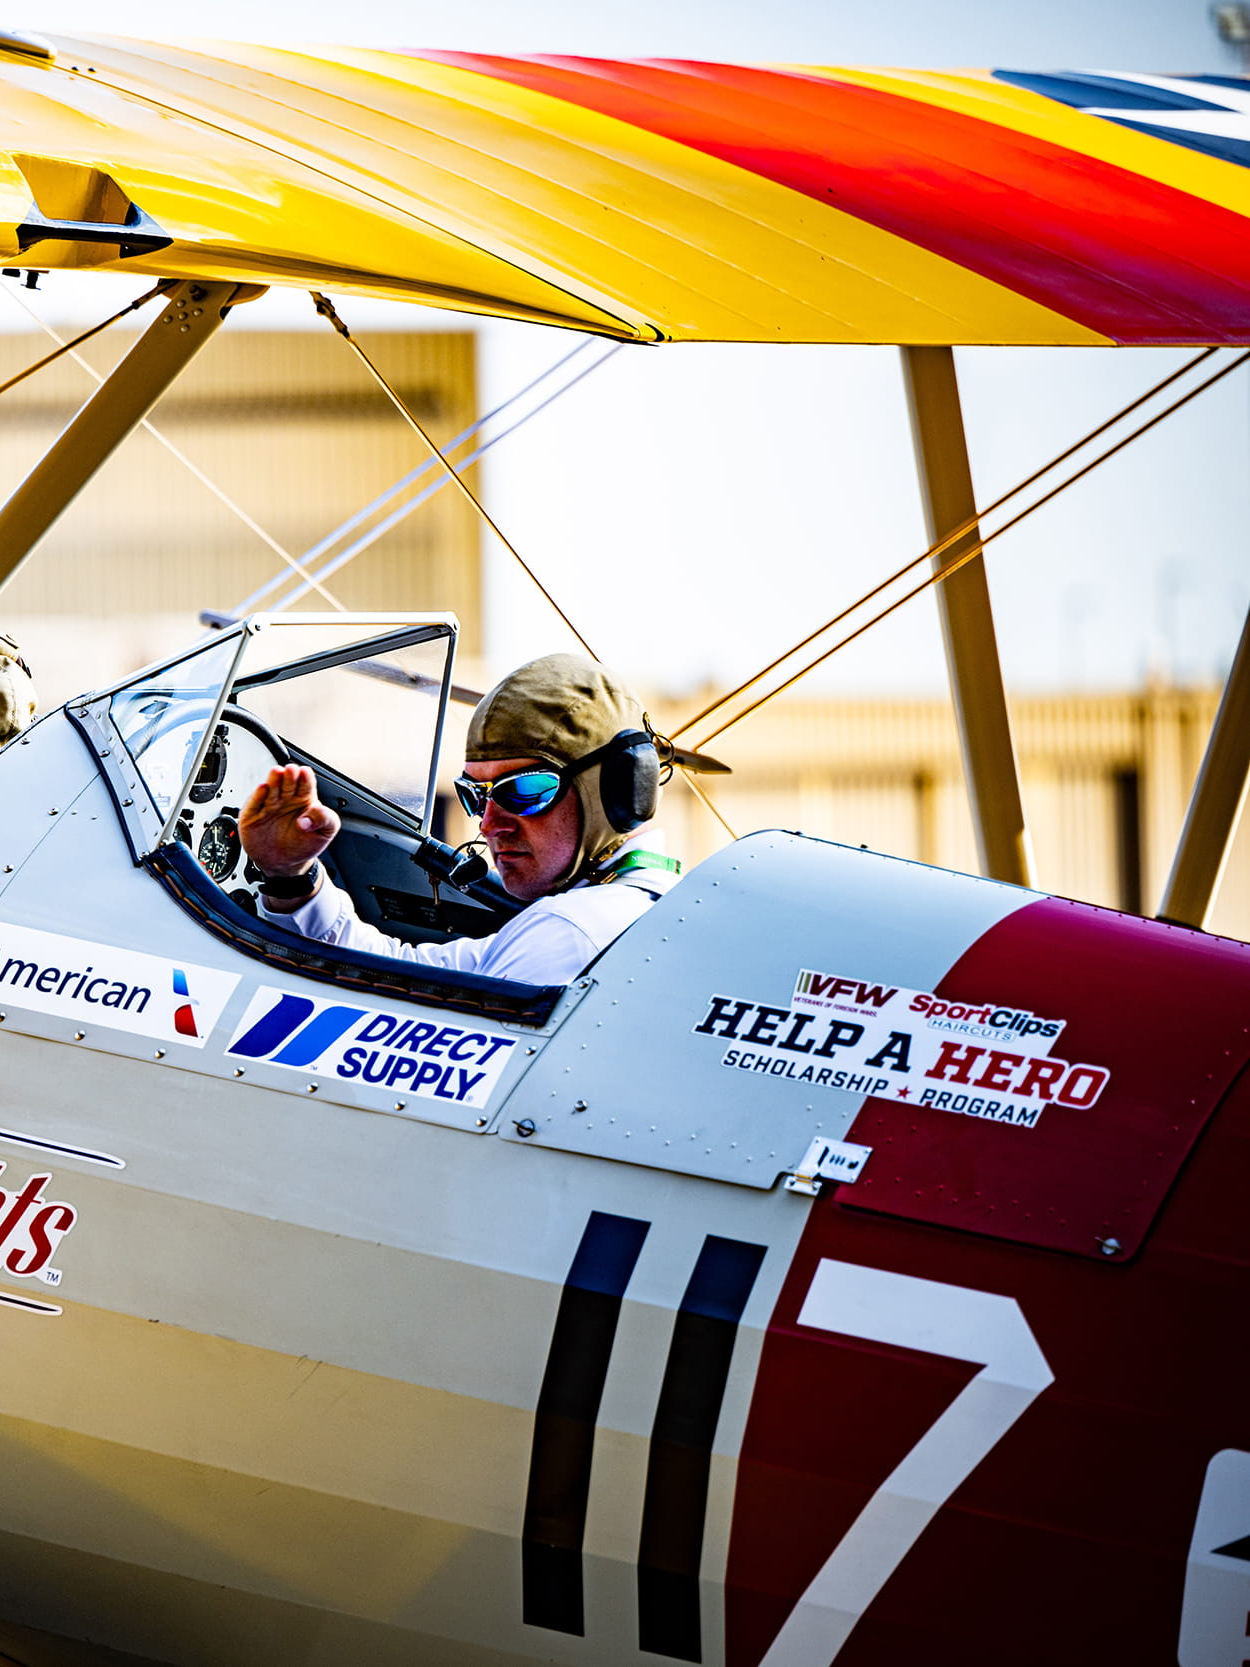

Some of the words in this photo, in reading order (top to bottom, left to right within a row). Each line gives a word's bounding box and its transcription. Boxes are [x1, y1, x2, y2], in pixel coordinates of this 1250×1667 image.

[809, 974, 899, 1008] VFW
[356, 1014, 517, 1066] DIRECT
[696, 997, 865, 1058] HELP
[865, 1031, 913, 1073] A
[925, 1041, 1106, 1107] HERO
[932, 1019, 1012, 1042] HAIRCUTS
[337, 1046, 486, 1101] SUPPLY
[722, 1049, 889, 1095] SCHOLARSHIP
[919, 1088, 1040, 1127] PROGRAM
[758, 1257, 1055, 1667] 7
